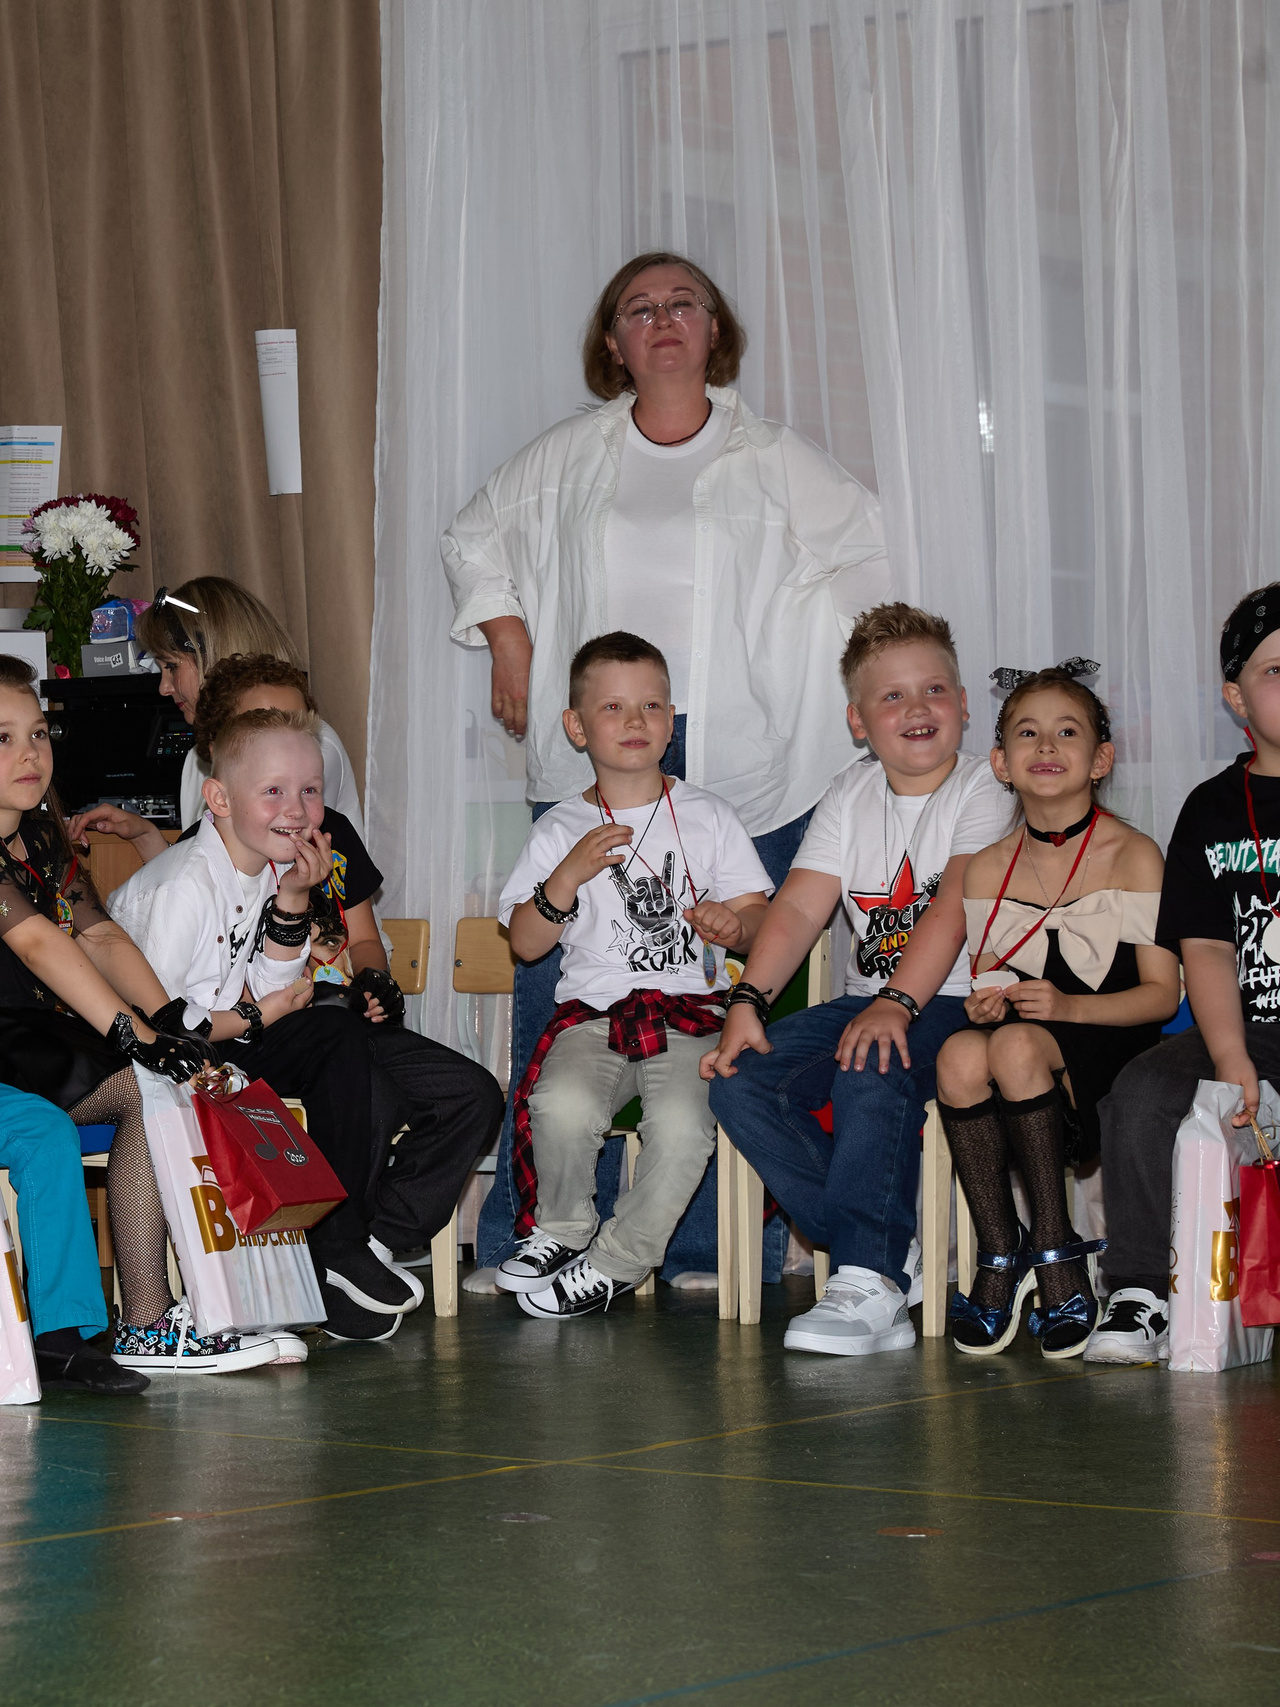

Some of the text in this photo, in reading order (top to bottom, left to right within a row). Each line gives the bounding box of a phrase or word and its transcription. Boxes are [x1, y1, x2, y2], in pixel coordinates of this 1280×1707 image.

[866, 902, 931, 937] ROCK
[626, 924, 698, 972] ROCK
[880, 932, 909, 953] AND
